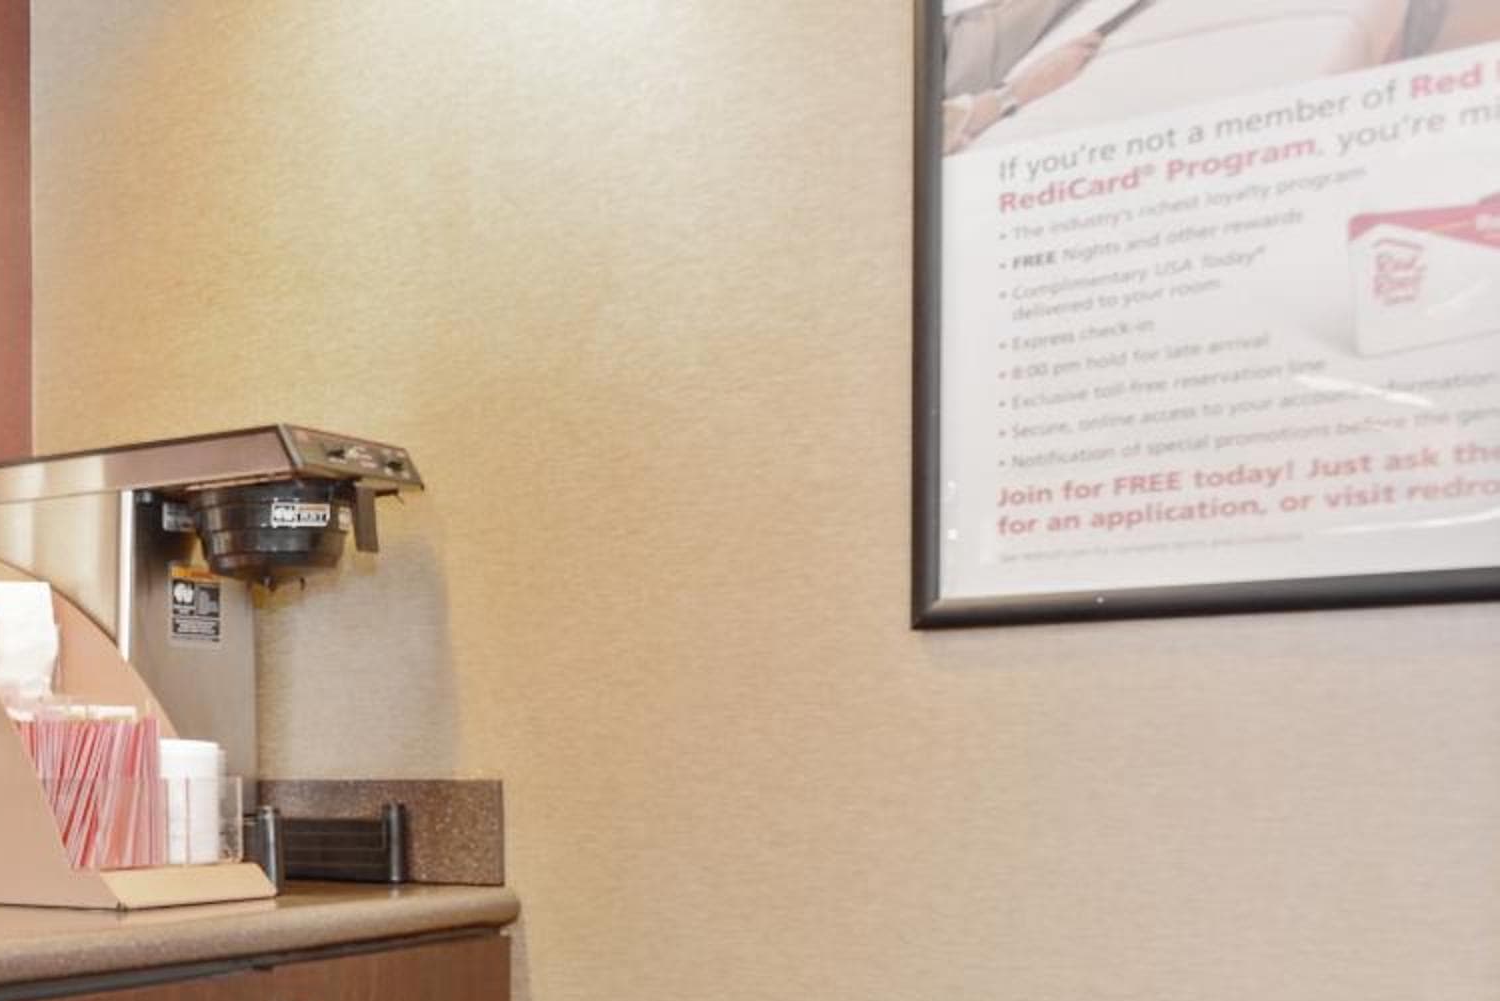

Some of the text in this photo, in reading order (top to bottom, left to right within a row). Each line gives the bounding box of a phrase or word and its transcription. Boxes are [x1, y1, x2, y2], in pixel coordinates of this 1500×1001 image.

[998, 156, 1017, 181] If
[1026, 142, 1117, 181] you're
[1125, 128, 1177, 156] not
[1187, 124, 1205, 145] a
[1214, 97, 1351, 138] member
[1360, 79, 1397, 110] of
[1409, 63, 1484, 99] Red
[1336, 111, 1446, 157] you're
[1275, 166, 1368, 195] program
[1011, 249, 1057, 270] FREE
[1126, 233, 1161, 251] and
[1166, 225, 1220, 244] other
[1222, 208, 1304, 235] rewards
[1011, 266, 1148, 301] Complimentary
[1154, 258, 1193, 277] USA
[1011, 277, 1221, 321] delivered to your room
[1011, 331, 1076, 352] Express
[1052, 360, 1081, 377] pm
[1085, 351, 1128, 369] hold
[1132, 348, 1160, 362] for
[1164, 343, 1202, 360] late
[1206, 330, 1271, 352] arrival
[1011, 388, 1089, 411] Exclusive
[1171, 364, 1284, 389] reservation
[1286, 358, 1327, 374] line
[1077, 413, 1135, 432] online
[1140, 406, 1197, 424] access
[1201, 402, 1224, 416] to
[1228, 398, 1273, 418] your
[1011, 446, 1117, 468] Notification
[1120, 442, 1142, 458] of
[1145, 435, 1211, 457] special
[1213, 424, 1330, 450] promotions
[997, 484, 1053, 508] Join
[1060, 479, 1105, 500] for
[1111, 470, 1182, 497] FREE
[1192, 459, 1296, 488] today!
[1308, 454, 1373, 480] Just
[1383, 447, 1440, 472] ask
[997, 514, 1040, 536] for
[1046, 514, 1082, 532] an
[1089, 497, 1267, 532] application,
[1278, 494, 1316, 512] or
[1322, 482, 1398, 509] visit
